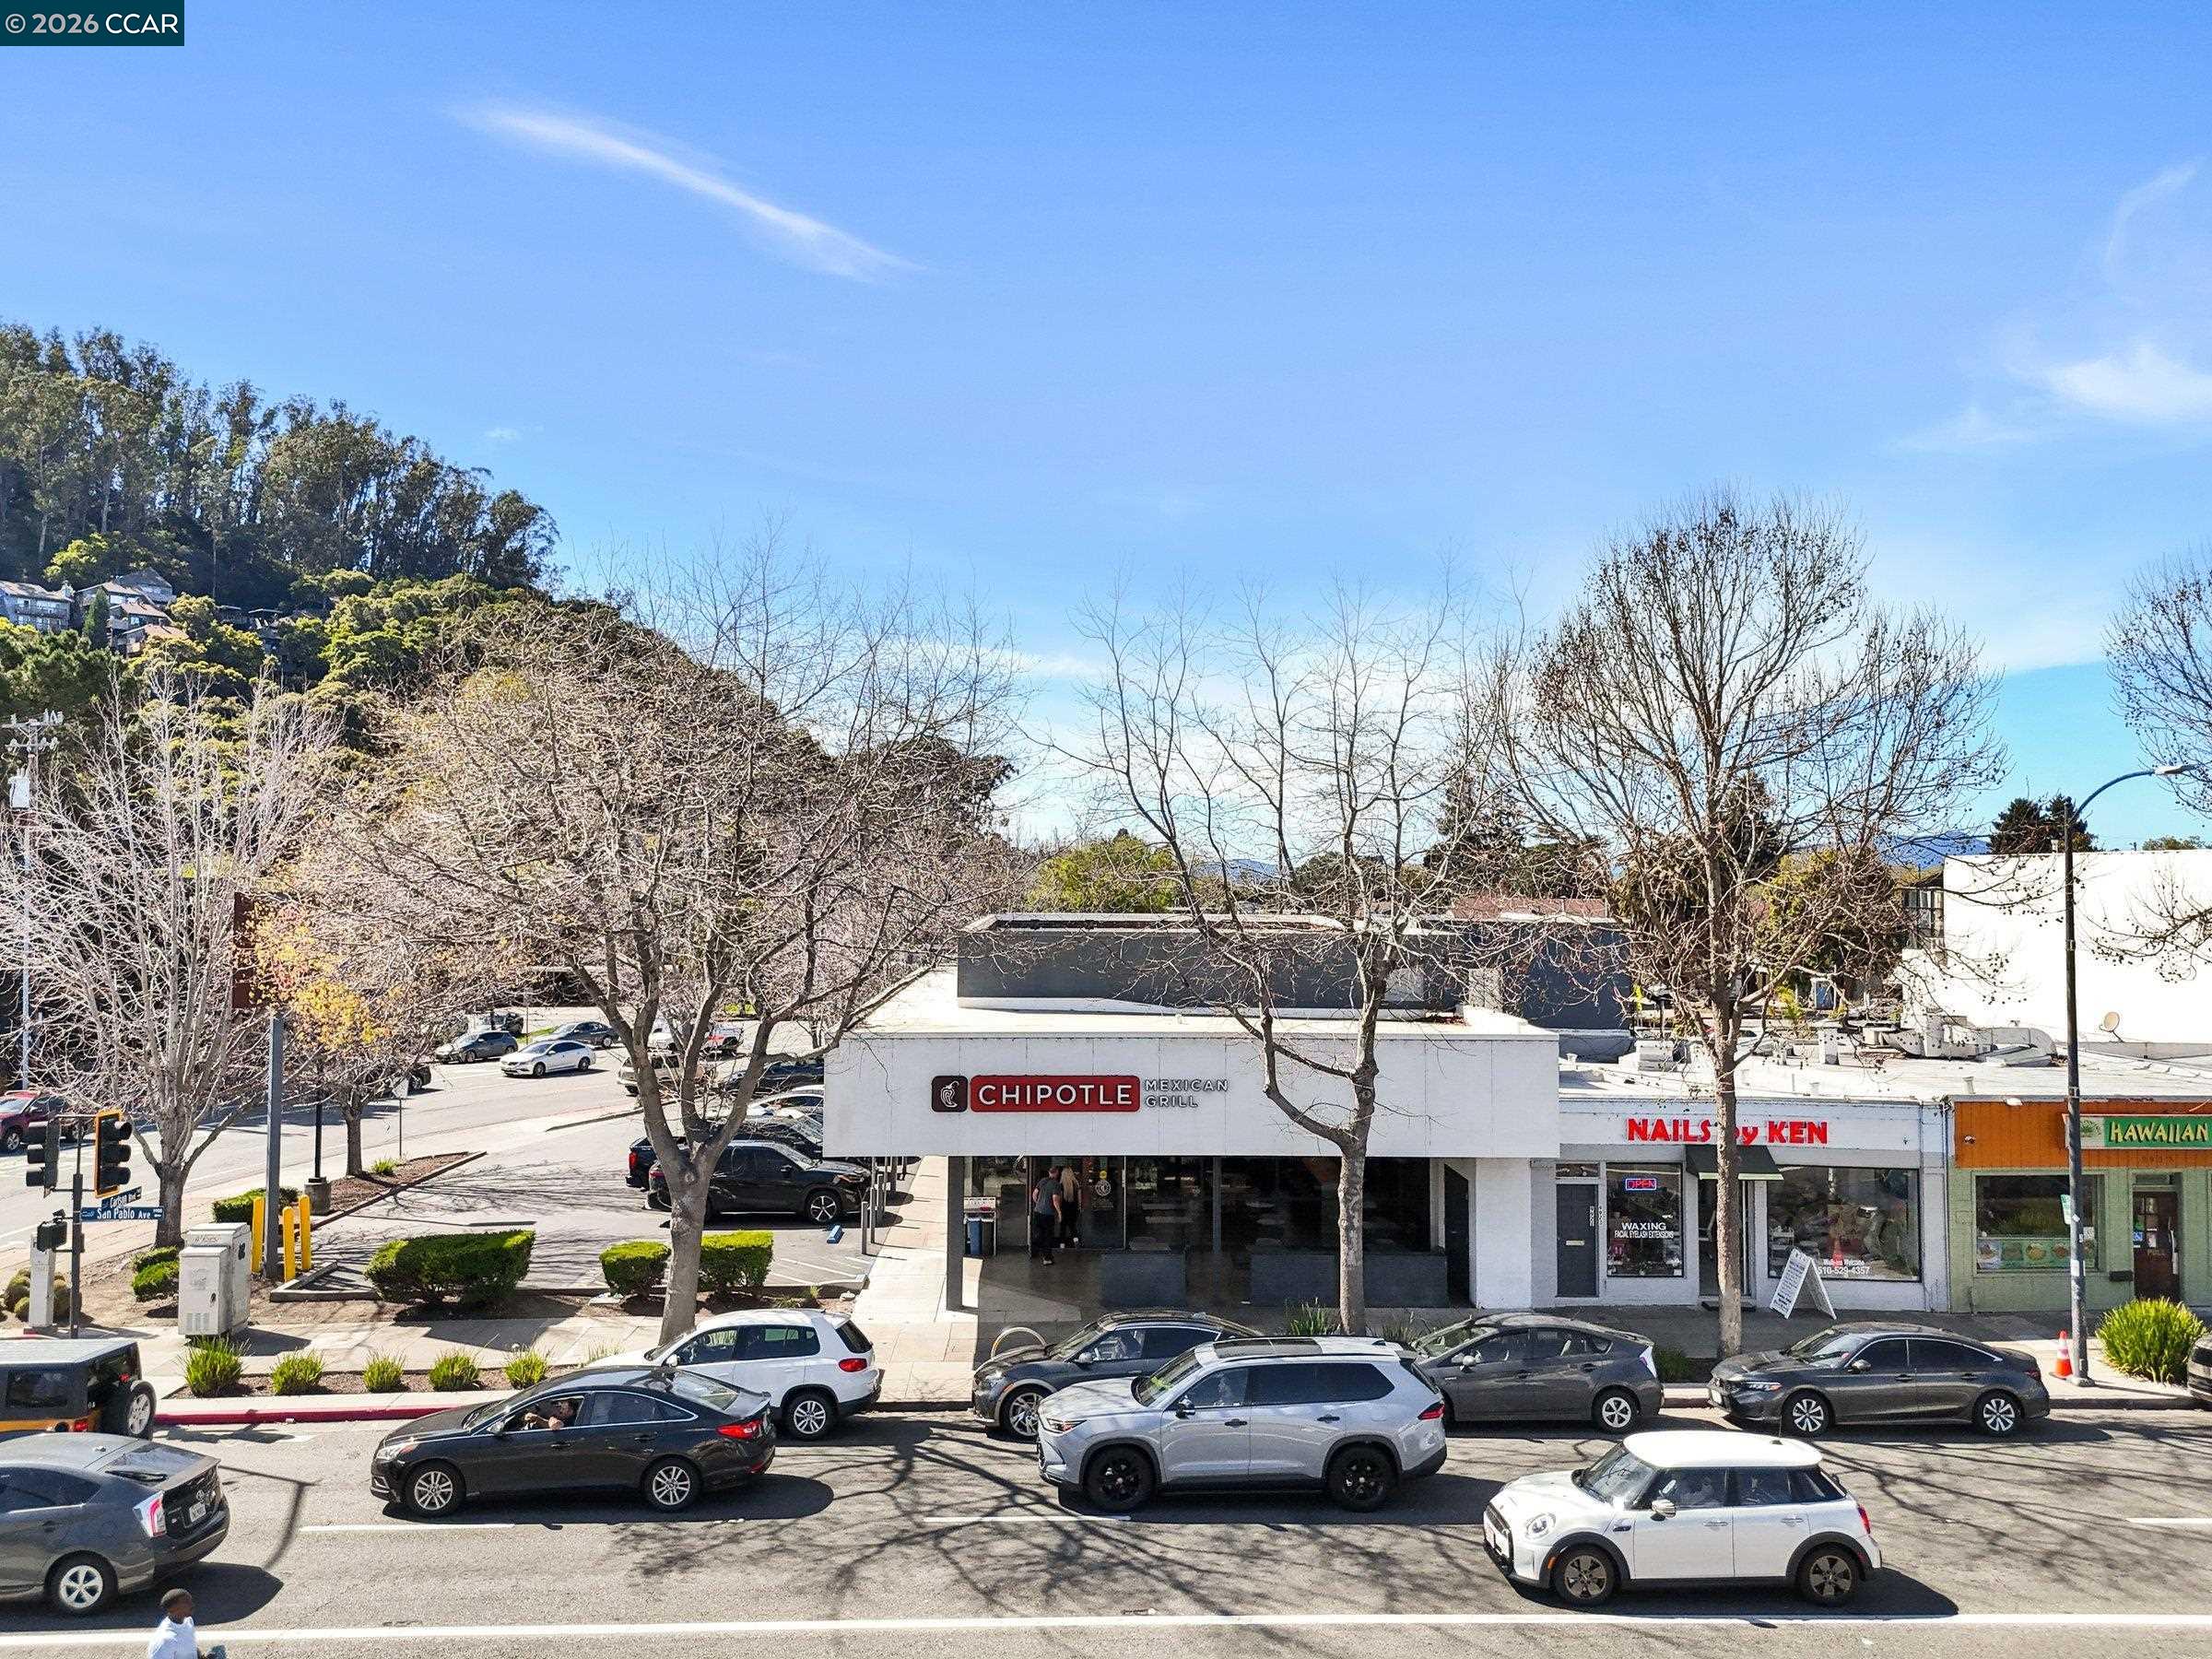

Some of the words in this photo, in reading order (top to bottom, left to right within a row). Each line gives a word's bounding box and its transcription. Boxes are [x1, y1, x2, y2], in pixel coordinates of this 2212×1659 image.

[1145, 1078, 1230, 1092] MEXICAN
[979, 1084, 1133, 1107] CHIPOTLE
[1145, 1094, 1199, 1108] GRILL
[1627, 1117, 1712, 1144] NAILS
[1767, 1120, 1829, 1145] KEN
[2109, 1121, 2209, 1143] HAWAIIAN
[1628, 1179, 1656, 1189] OPEN
[97, 1207, 112, 1219] San
[113, 1207, 135, 1219] Pablo
[138, 1210, 151, 1219] Ave
[1621, 1221, 1667, 1230] WAXING
